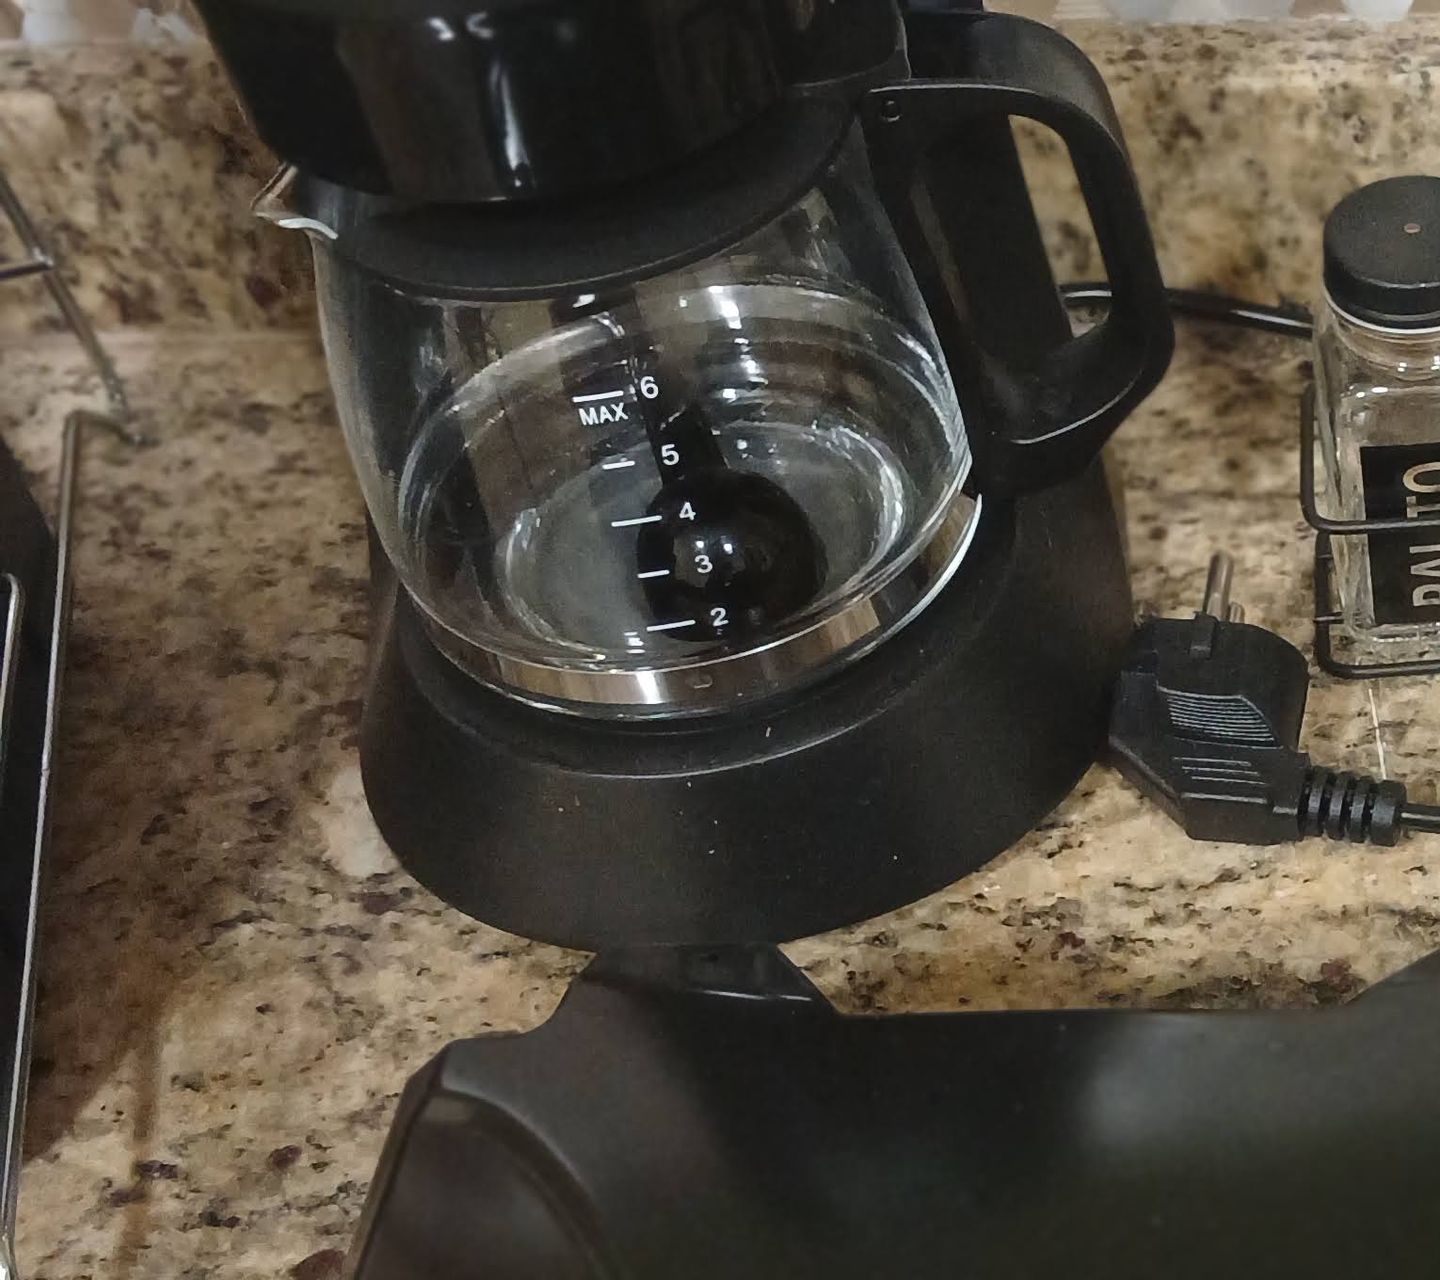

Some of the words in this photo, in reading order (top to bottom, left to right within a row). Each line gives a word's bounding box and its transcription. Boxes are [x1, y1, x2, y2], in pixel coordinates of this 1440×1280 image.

[639, 375, 659, 399] 6
[578, 401, 629, 427] MAX
[660, 443, 680, 466] 5
[678, 501, 697, 522] 4
[693, 554, 714, 574] 3
[709, 606, 729, 627] 2
